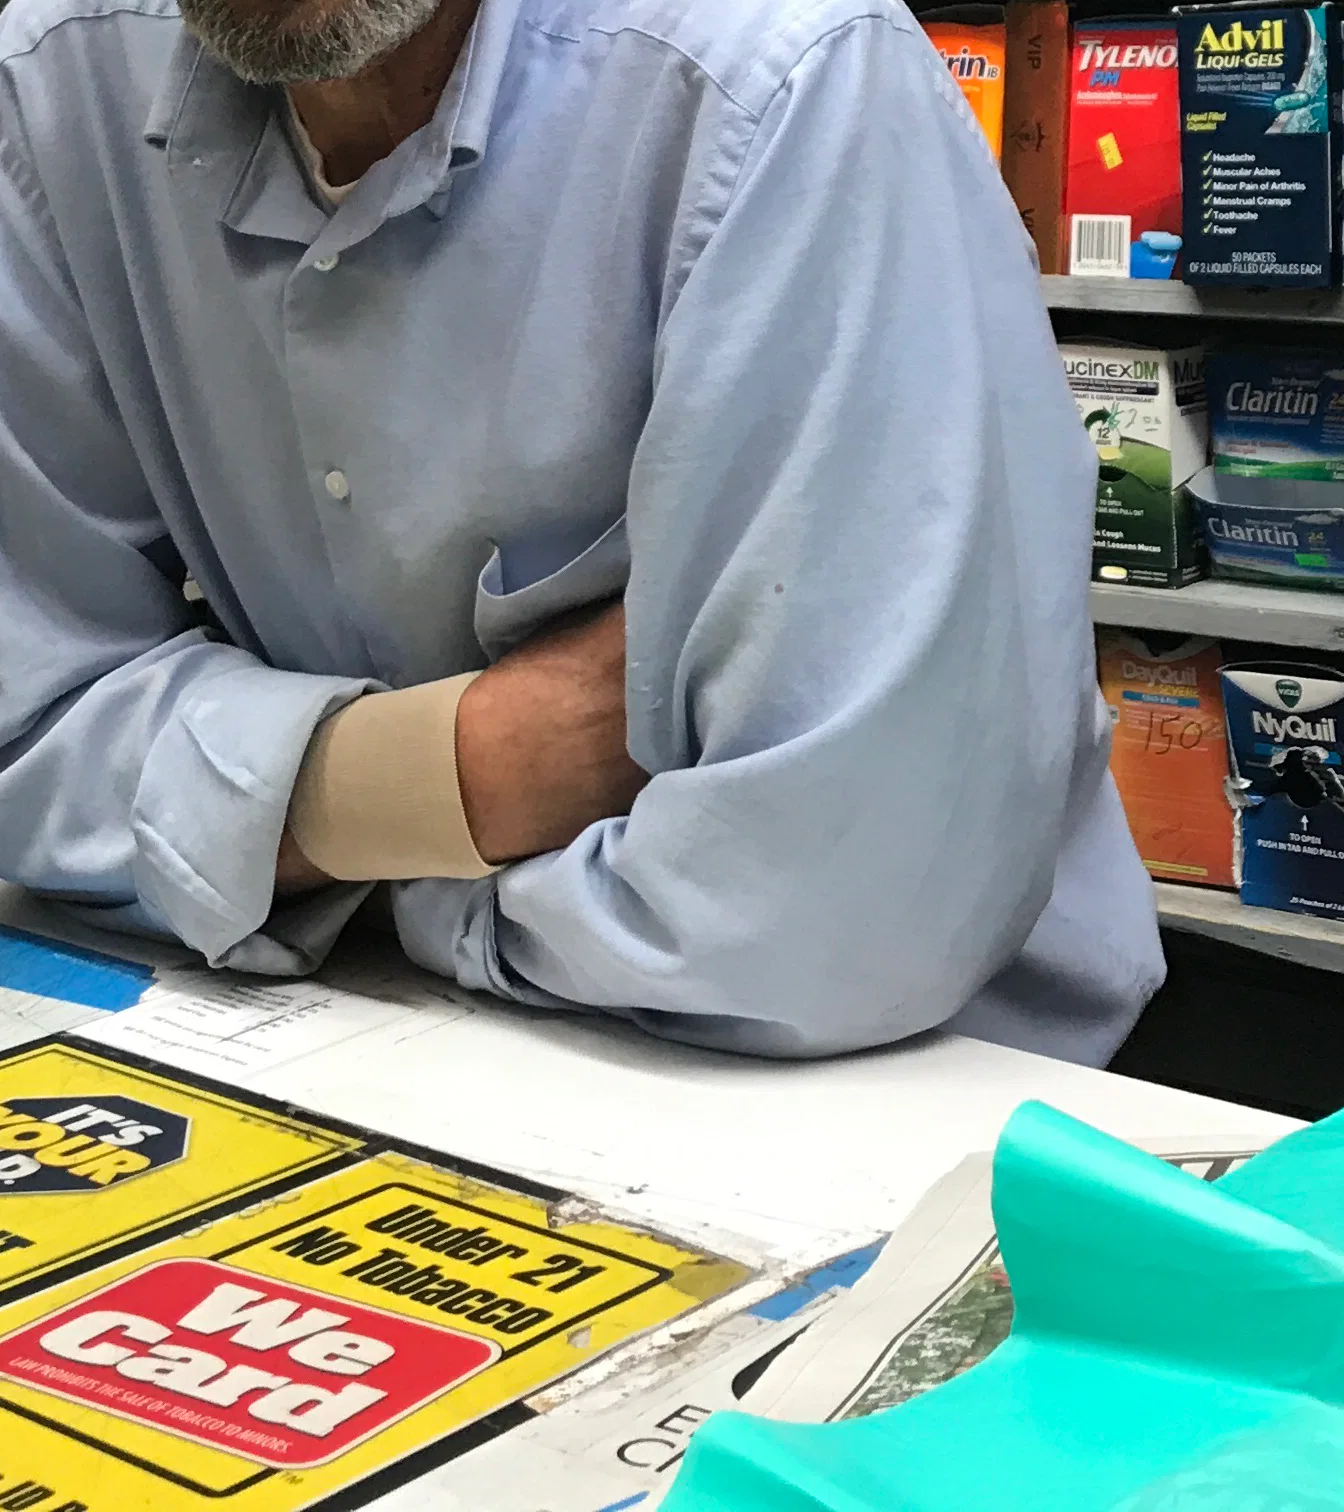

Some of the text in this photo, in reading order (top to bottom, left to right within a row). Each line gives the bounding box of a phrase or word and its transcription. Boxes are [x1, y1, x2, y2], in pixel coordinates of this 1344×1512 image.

[1079, 40, 1178, 71] TYLENO
[1090, 70, 1121, 86] PM
[1213, 153, 1256, 162] Headache
[1213, 166, 1281, 176] Muscular Aches
[1213, 181, 1306, 190] Minor Pain of Arthritis
[1213, 196, 1292, 207] Menstrual Cramps
[1213, 210, 1258, 220] Toothache
[1213, 224, 1237, 234] Fever
[1226, 381, 1319, 415] Claritin
[1207, 517, 1299, 547] Claritin
[1122, 659, 1197, 686] DayQuil
[1252, 710, 1336, 744] NyQuil
[41, 1103, 164, 1147] IT'S
[365, 1203, 608, 1293] Under 21
[271, 1226, 554, 1334] No Tobacco
[175, 1282, 395, 1376] We
[39, 1310, 389, 1438] Card
[0, 1480, 56, 1511] ID
